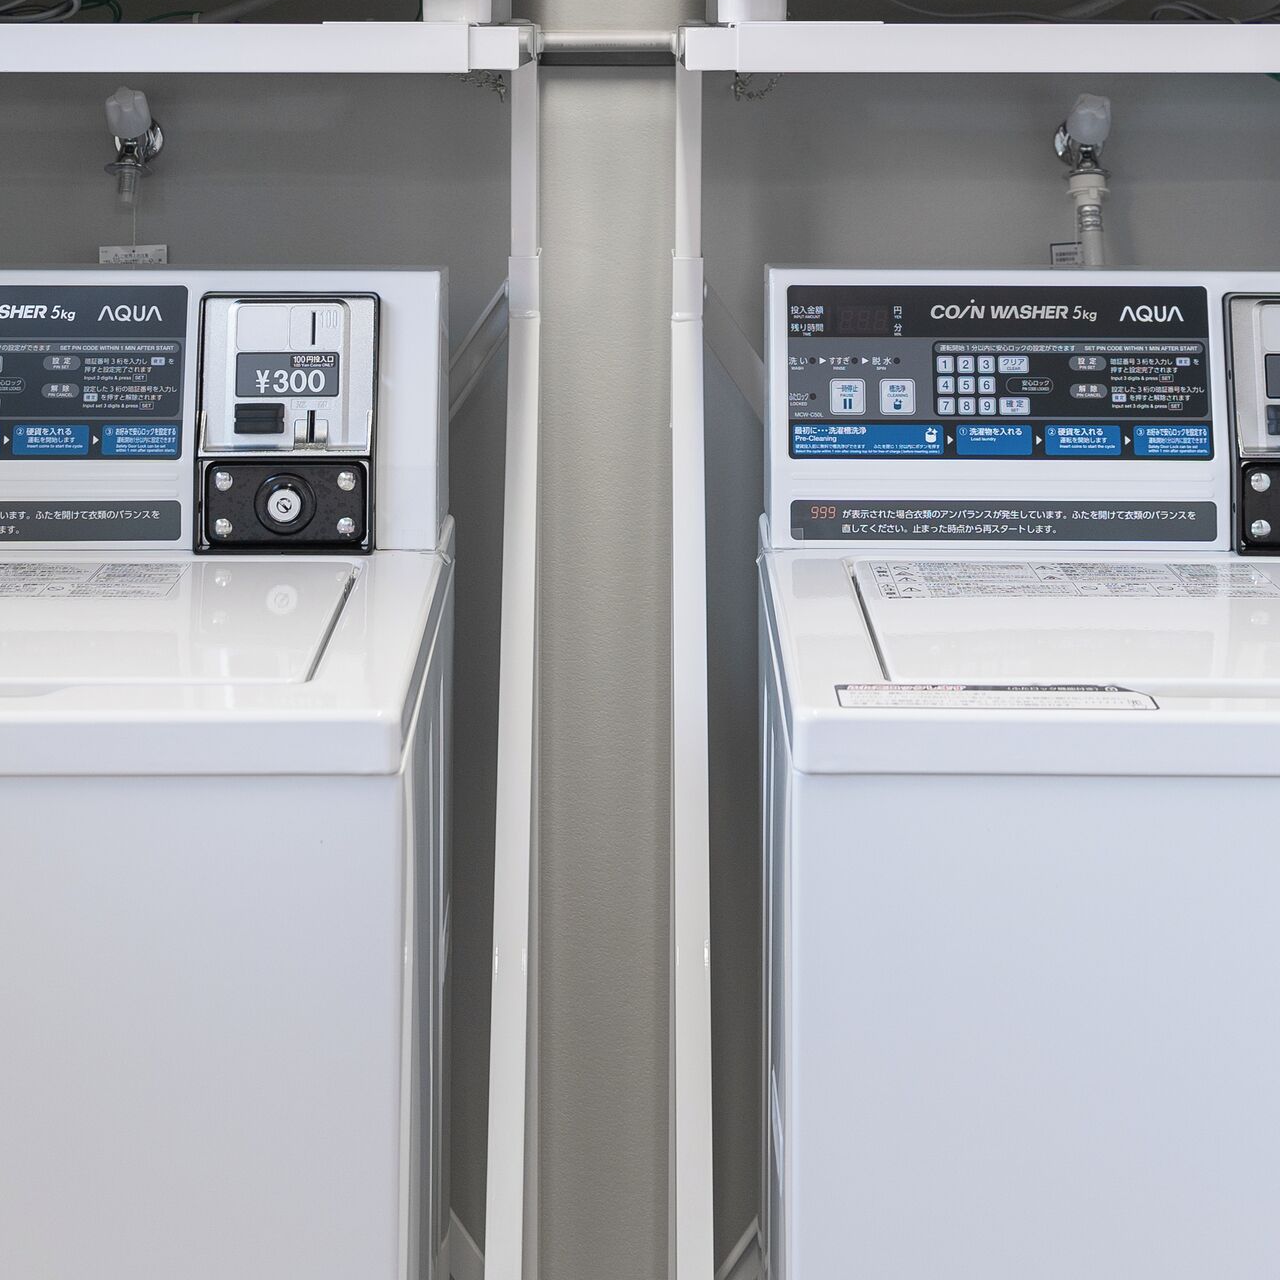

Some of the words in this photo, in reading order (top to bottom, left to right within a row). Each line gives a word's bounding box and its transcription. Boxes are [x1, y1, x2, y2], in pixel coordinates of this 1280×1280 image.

[51, 306, 76, 321] 5kg
[97, 305, 162, 322] AQUA
[791, 306, 823, 314] 投入金額
[930, 299, 985, 319] COIN
[991, 306, 1068, 319] WASHER
[1073, 306, 1097, 321] 5kg
[1120, 306, 1184, 322] AQUA
[791, 324, 824, 332] 残り時間
[293, 355, 334, 363] 100円投入口
[789, 357, 808, 365] 洗い
[829, 357, 850, 365] すすぎ
[872, 357, 892, 365] 脱水
[1003, 358, 1024, 366] クリア
[942, 360, 947, 369] 1
[963, 360, 969, 369] 2
[983, 360, 990, 369] 3
[256, 370, 325, 393] ¥300
[942, 381, 949, 389] 4
[963, 381, 969, 389] 5
[983, 381, 990, 389] 6
[889, 385, 906, 393] 槽洗浄
[943, 402, 949, 410] 7
[964, 402, 970, 410] 8
[984, 402, 990, 410] 9
[1006, 400, 1024, 408] 確定
[27, 428, 72, 436] 硬貨を入れる
[969, 428, 1022, 436] 洗濯物を入れる
[1058, 428, 1103, 436] 硬貨を入れる
[811, 507, 836, 519] 999
[842, 524, 1058, 534] 直してください。止まった時点から再スタートします。
